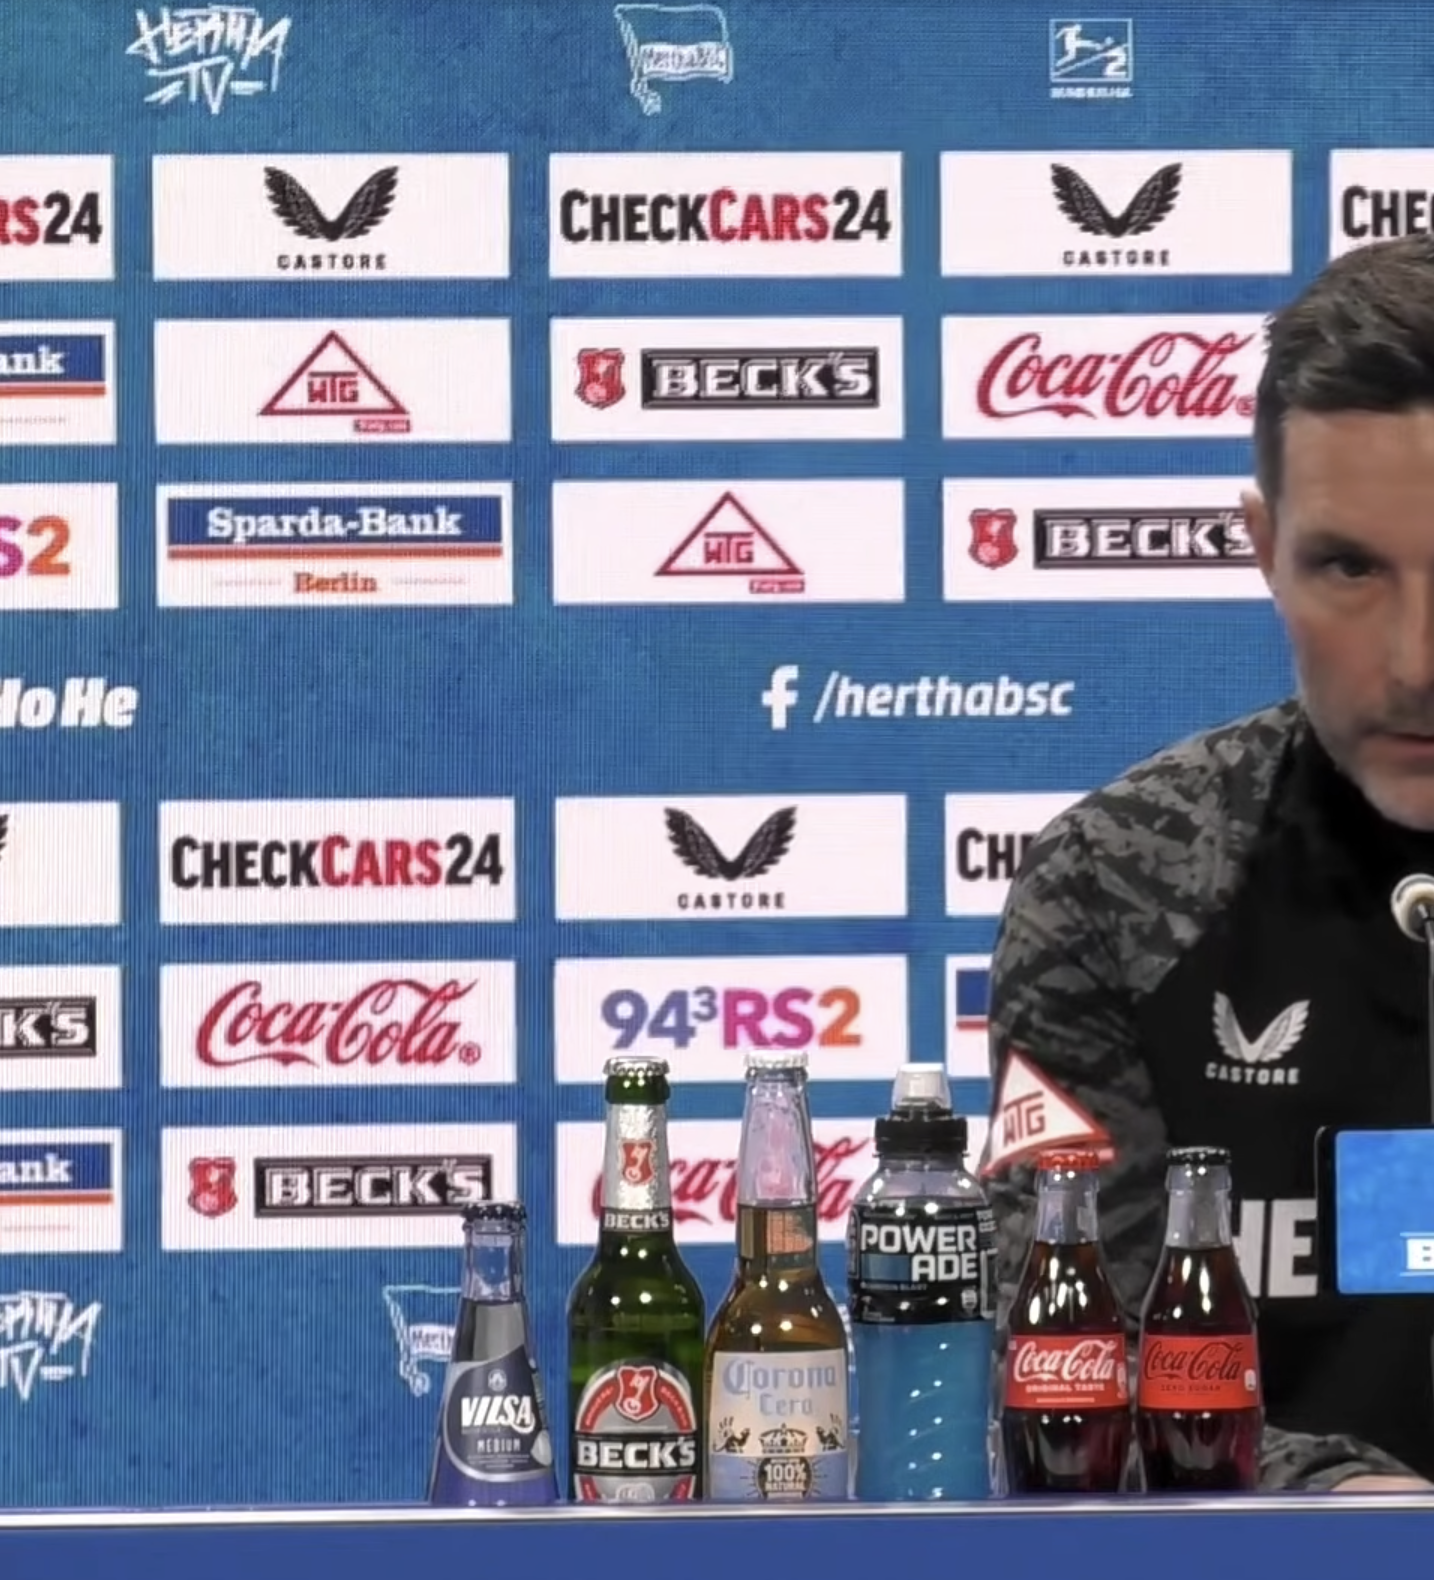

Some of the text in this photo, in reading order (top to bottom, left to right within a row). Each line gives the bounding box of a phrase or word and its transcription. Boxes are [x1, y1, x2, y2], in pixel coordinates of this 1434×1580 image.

[277, 254, 387, 270] CASTORE
[1062, 249, 1171, 267] CASTORE
[654, 350, 872, 398] BECK'S
[976, 331, 1257, 420] Coca-Cola
[207, 506, 462, 543] Sparda-Bank
[1046, 512, 1254, 557] BECK'S
[293, 571, 378, 594] Berlin
[61, 677, 139, 728] He
[813, 671, 1075, 723] /herthabsc
[677, 893, 786, 910] CASTORE
[196, 977, 479, 1069] Coca-Cola
[1205, 1062, 1300, 1085] CASTORE
[264, 1157, 485, 1207] BECK'S
[604, 1210, 670, 1230] BECK'S
[861, 1224, 977, 1253] POWER
[911, 1252, 978, 1282] ADE
[1014, 1339, 1117, 1382] Coca-Cola
[1144, 1341, 1245, 1381] Coca-Cola
[723, 1359, 837, 1399] Corona
[461, 1394, 536, 1434] VILSA
[759, 1392, 814, 1417] Cero
[477, 1438, 521, 1453] MEDIUM
[577, 1436, 696, 1469] BECK'S
[764, 1463, 807, 1482] 100%
